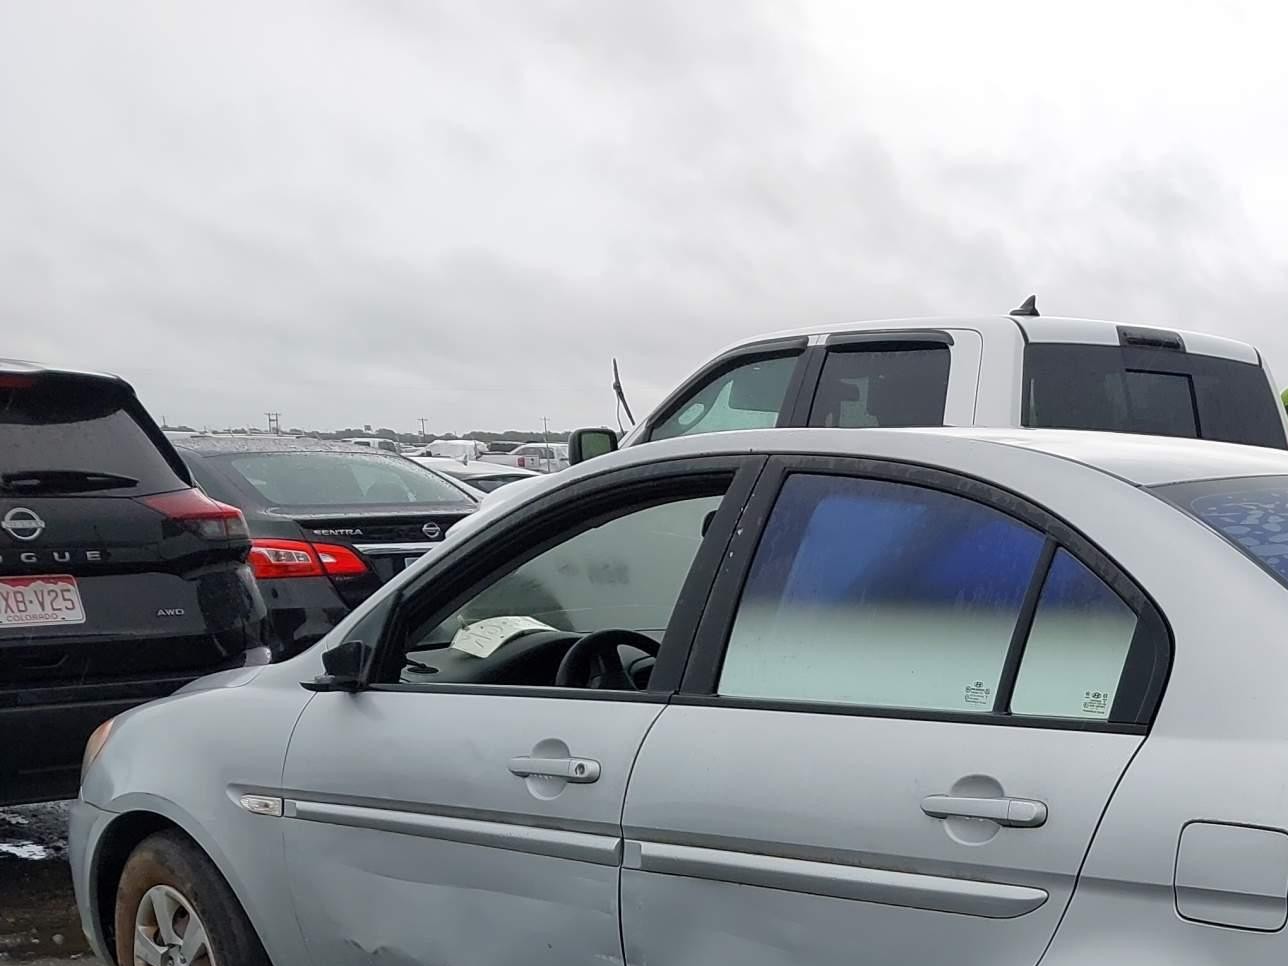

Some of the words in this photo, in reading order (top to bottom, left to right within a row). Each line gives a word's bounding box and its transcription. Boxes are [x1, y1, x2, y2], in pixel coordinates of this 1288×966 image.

[313, 528, 364, 537] SENTRA
[0, 550, 102, 563] GUE
[6, 612, 59, 622] COLORADO
[156, 607, 185, 617] AWD
